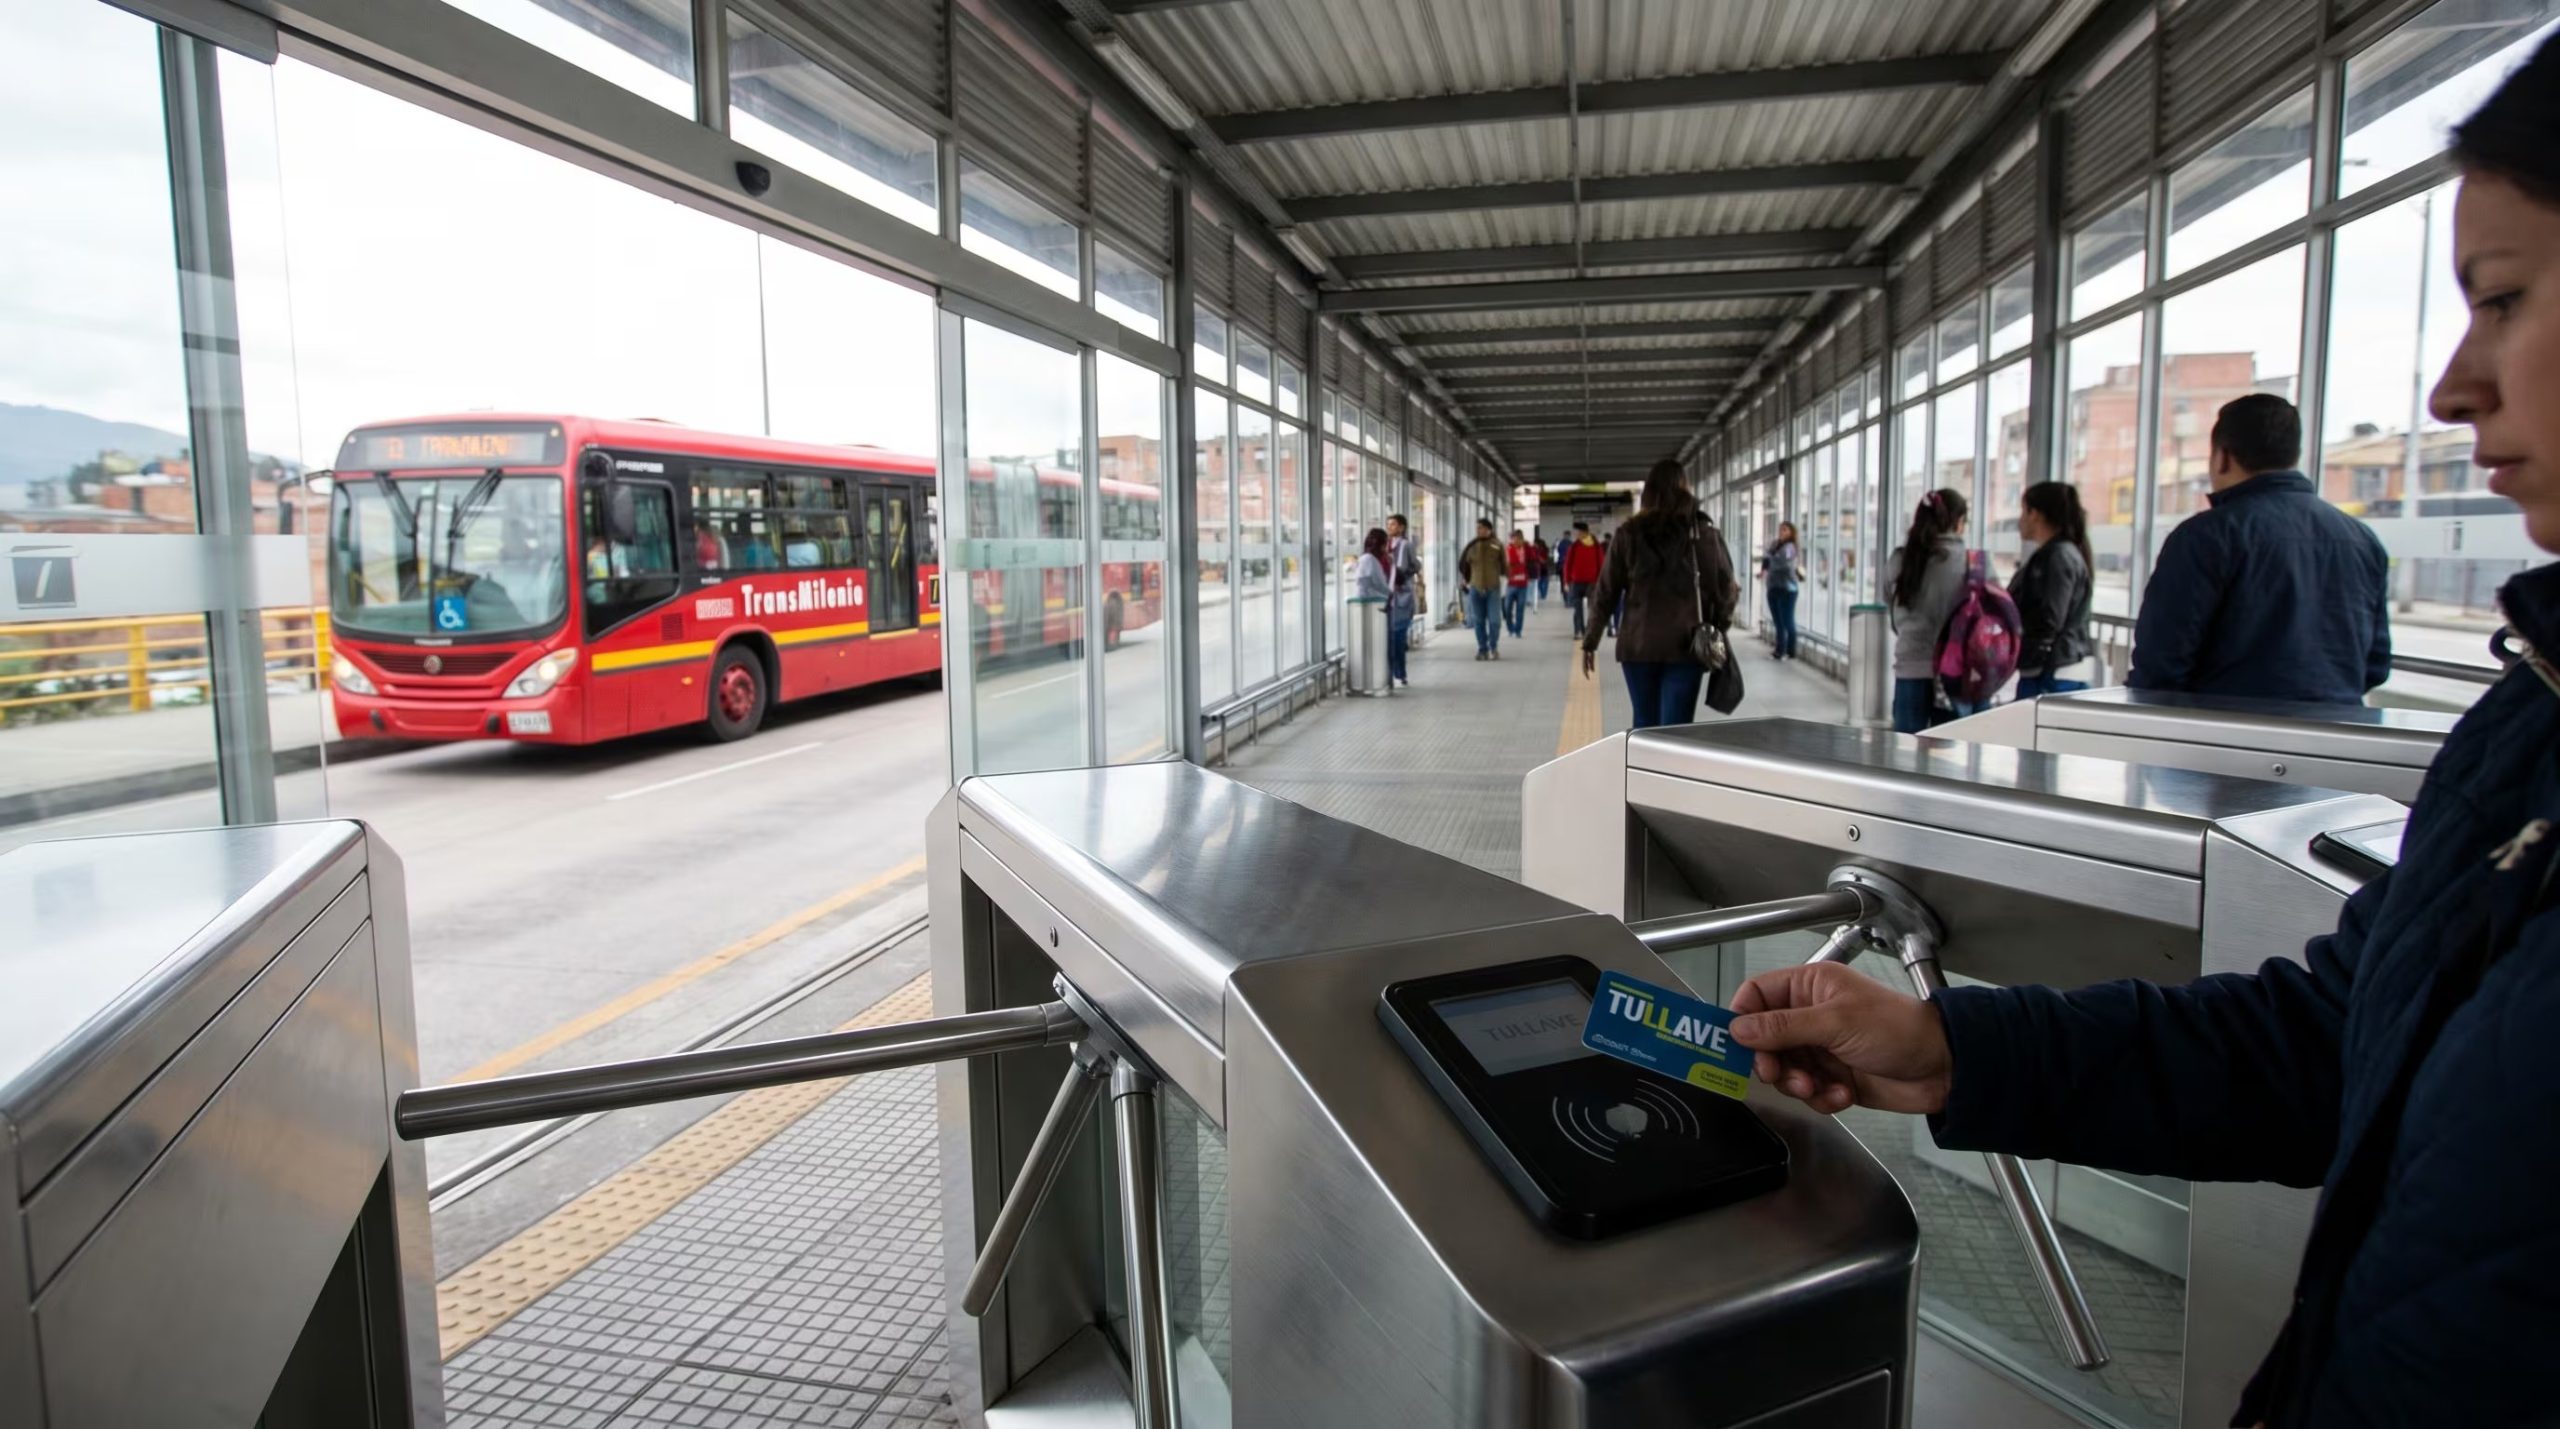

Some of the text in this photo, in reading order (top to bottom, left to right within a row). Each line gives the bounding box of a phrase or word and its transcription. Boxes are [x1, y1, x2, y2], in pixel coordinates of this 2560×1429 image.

[741, 577, 863, 616] TransMilenio
[1482, 1012, 1581, 1041] TULLAVE
[1608, 989, 1729, 1054] TULLAVE
